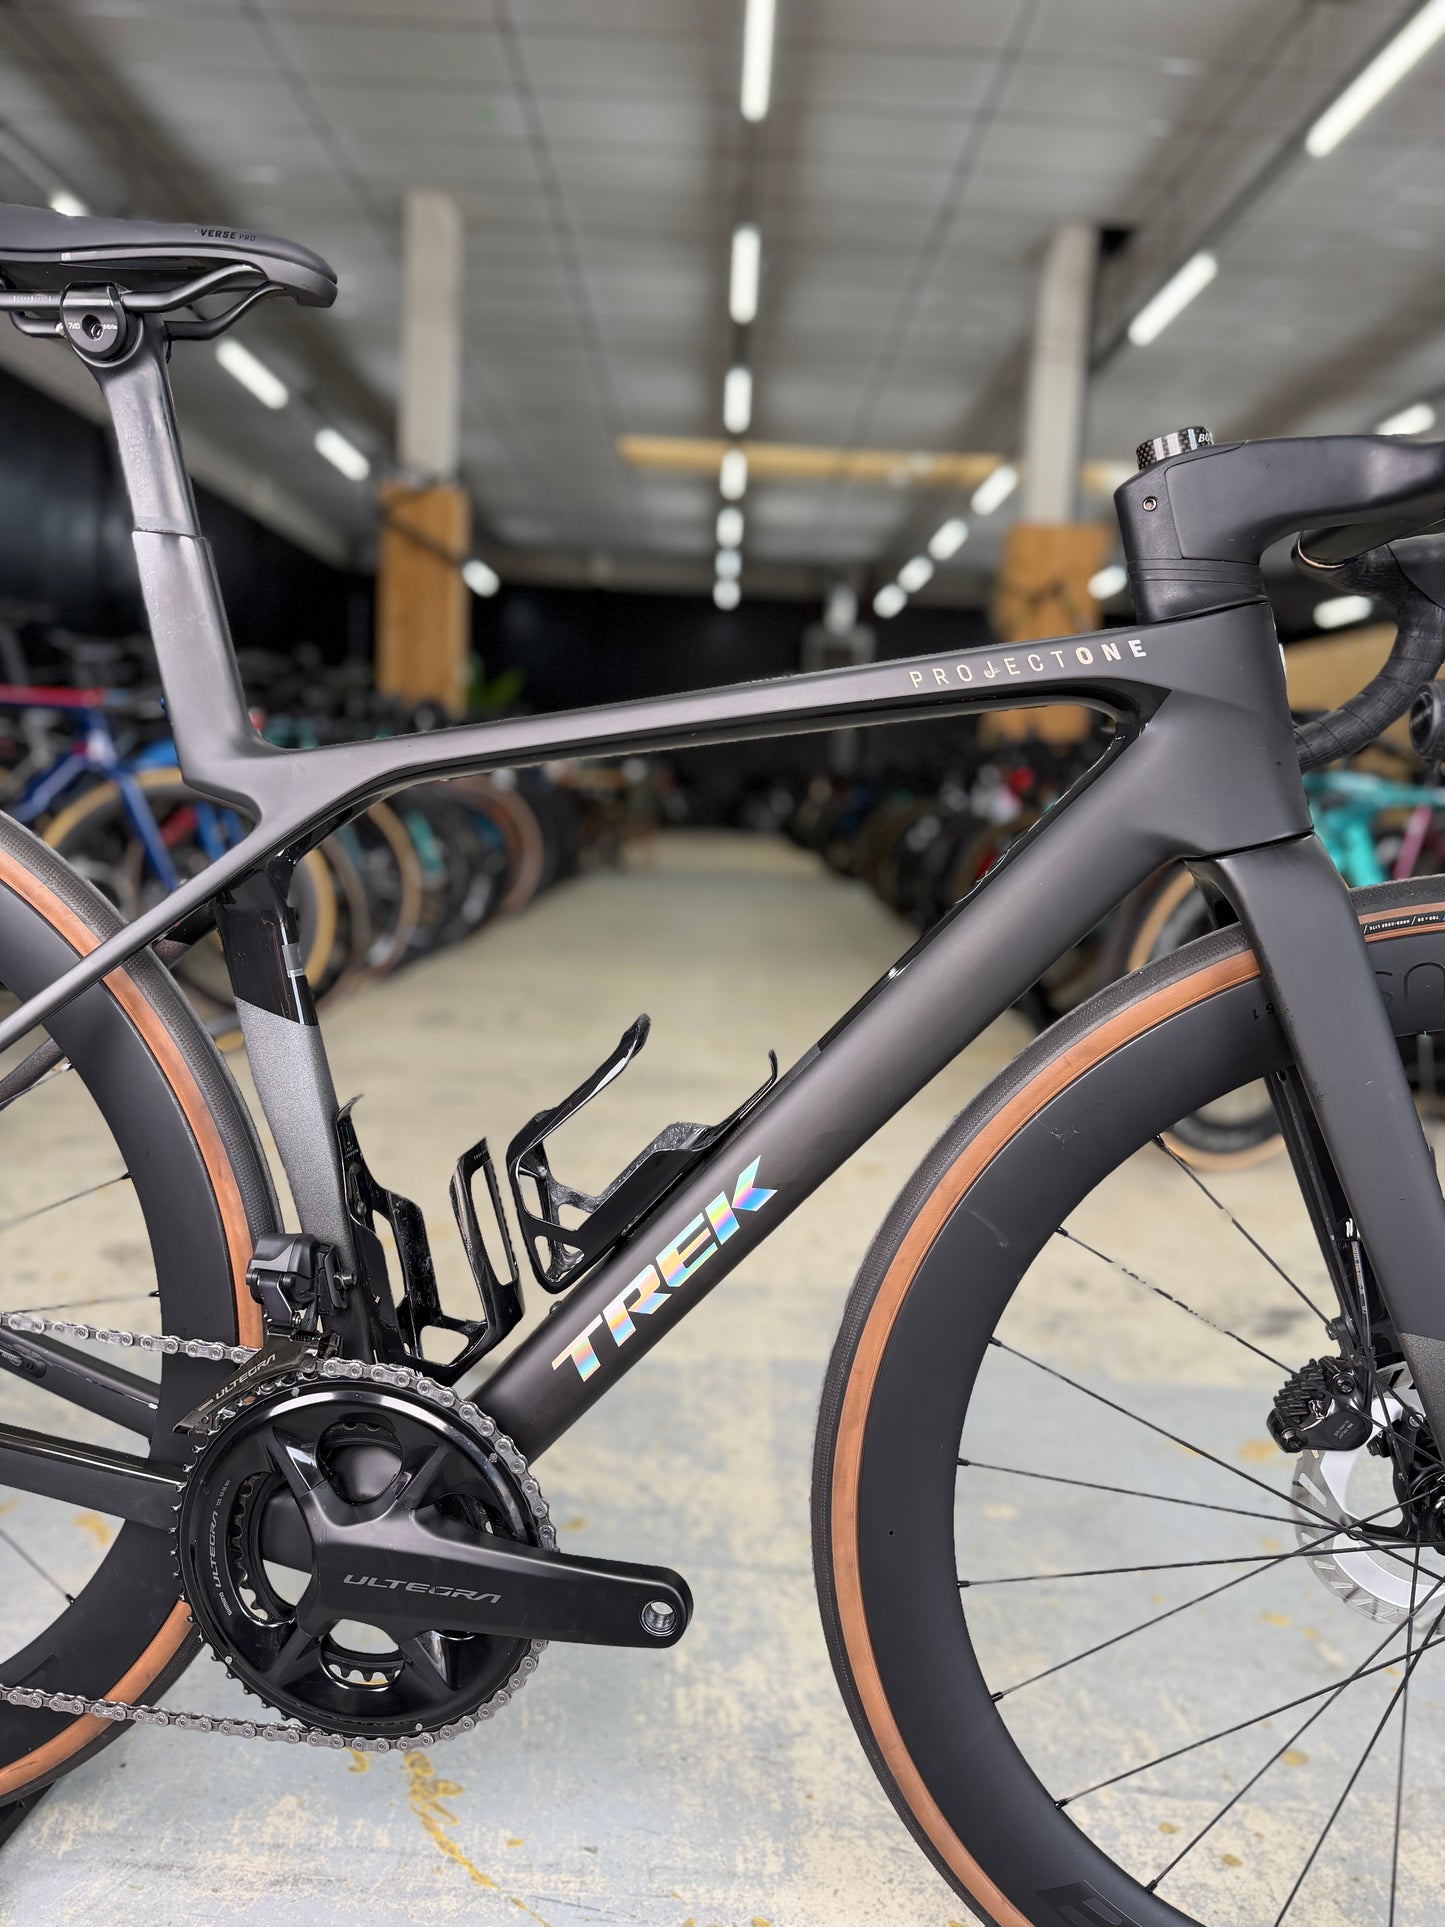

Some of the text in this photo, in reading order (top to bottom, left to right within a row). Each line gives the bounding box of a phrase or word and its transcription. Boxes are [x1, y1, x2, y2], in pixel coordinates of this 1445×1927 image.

[201, 229, 256, 241] VERSE PRO
[551, 1154, 778, 1382] TREK
[215, 1353, 276, 1400] ULTEGRA
[209, 1510, 222, 1588] ULTEGRA
[343, 1574, 502, 1604] ULTEGRA
